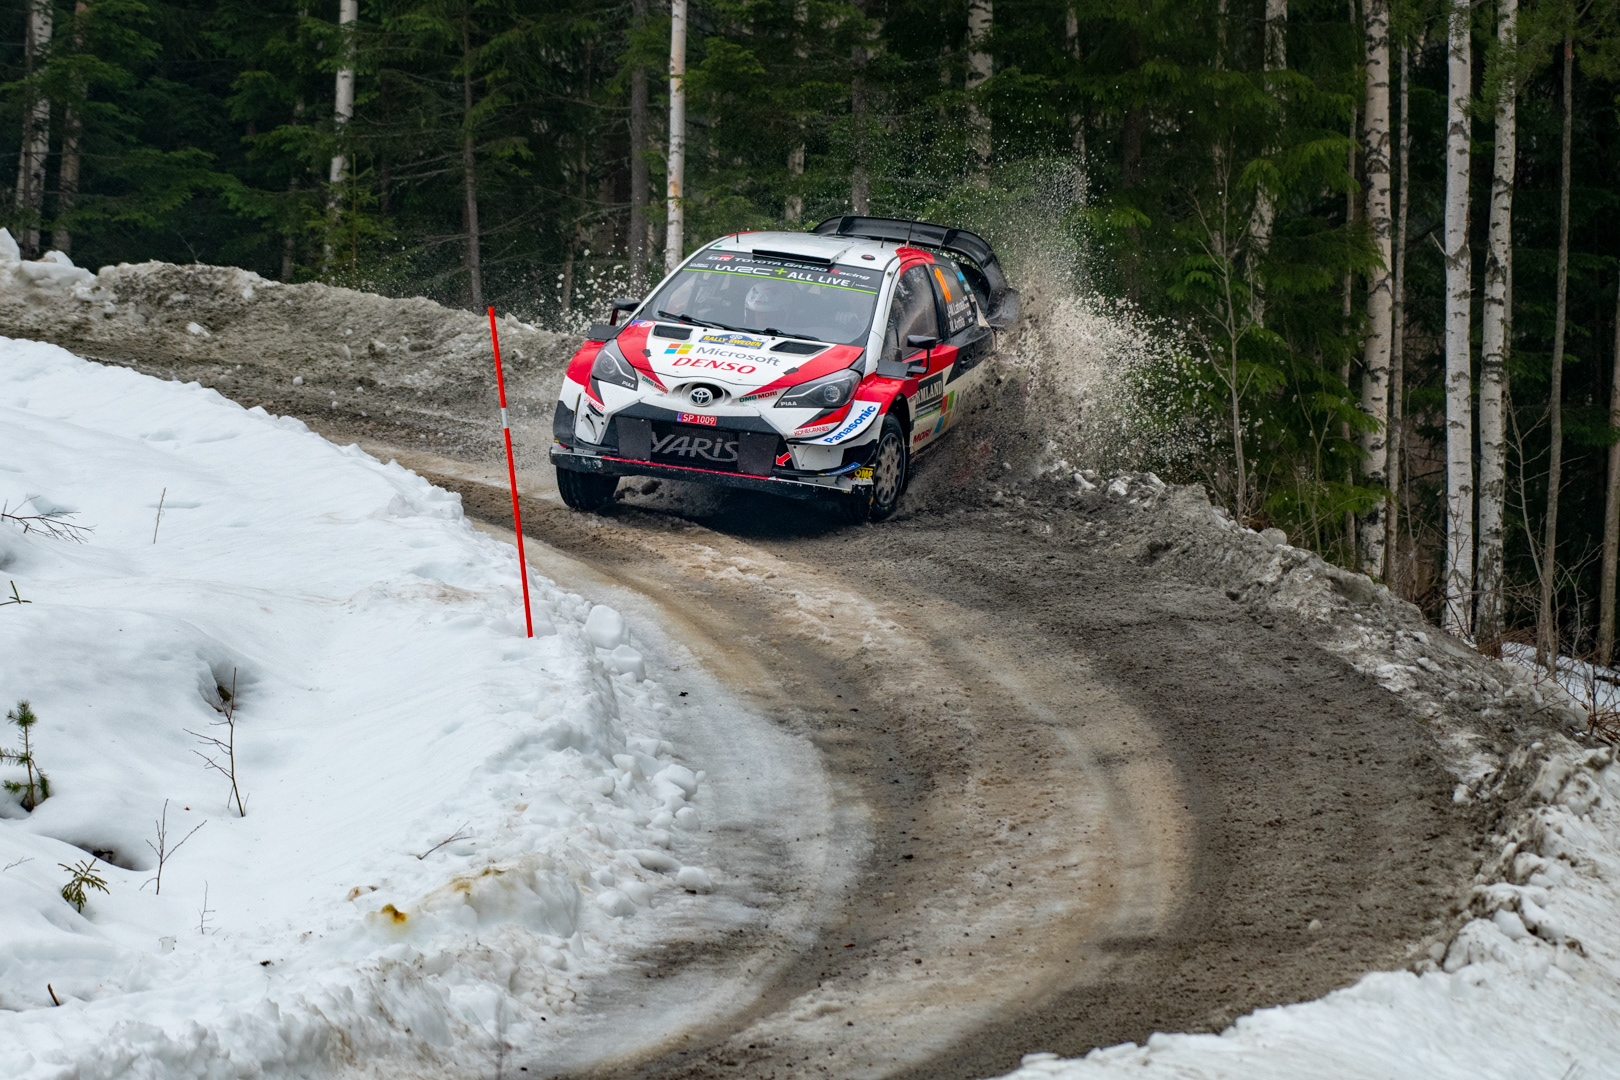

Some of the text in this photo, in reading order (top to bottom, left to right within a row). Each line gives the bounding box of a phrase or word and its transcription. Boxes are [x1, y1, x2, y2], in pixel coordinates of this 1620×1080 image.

[735, 257, 782, 266] TOYOTA
[784, 262, 828, 272] GAZOO
[829, 269, 870, 280] Racing
[787, 272, 814, 282] ALL
[818, 275, 850, 287] LIVE
[703, 335, 726, 343] RALLY
[729, 338, 762, 348] SWEDEN
[696, 347, 781, 366] Microsoft
[672, 357, 757, 375] DENSO
[621, 380, 635, 388] PIAA
[642, 375, 669, 394] DMG MORI
[739, 390, 778, 402] DMG MORI
[682, 413, 715, 425] SP 1009
[823, 405, 877, 443] Panasonic
[793, 426, 830, 436] KONECRANES
[854, 467, 874, 478] OMP
